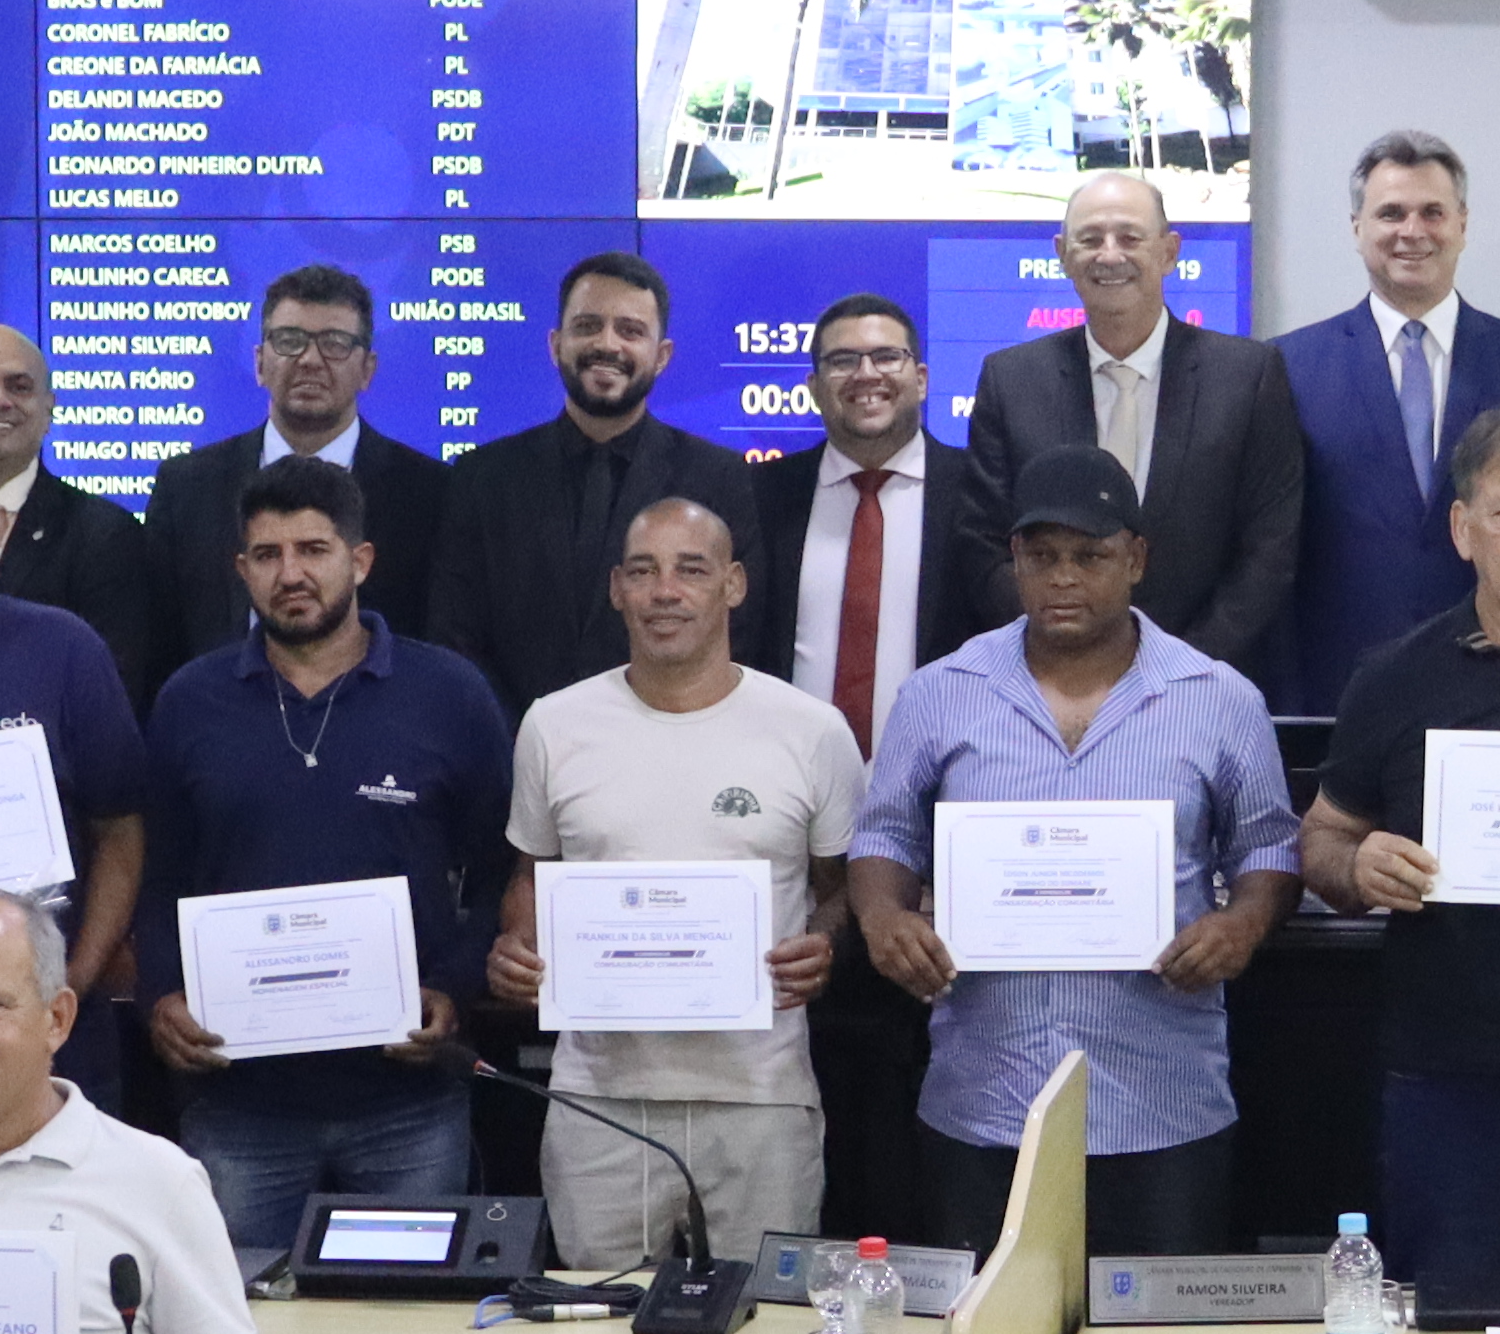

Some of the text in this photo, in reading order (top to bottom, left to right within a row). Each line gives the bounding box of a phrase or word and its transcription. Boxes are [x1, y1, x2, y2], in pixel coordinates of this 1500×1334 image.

[46, 18, 231, 44] CORONEL FABRÍCIO
[444, 22, 469, 42] PL
[47, 51, 262, 76] CREONE DA FARMÁCIA
[445, 55, 469, 76] PL
[48, 89, 224, 110] DELANDI MACEDO
[432, 89, 483, 109] PSDB
[47, 119, 208, 143] JOÃO MACHADO
[437, 122, 477, 142] PDT
[48, 155, 324, 176] LEONARDO PINHEIRO DUTRA
[432, 155, 483, 176] PSDB
[49, 188, 179, 209] LUCAS MELLO
[445, 189, 470, 209] PL
[50, 233, 217, 254] MARCOS COELHO
[440, 234, 476, 254] PSB
[50, 267, 230, 287] PAULINHO CARECA
[431, 267, 485, 287] PODE
[1177, 260, 1201, 280] 19
[50, 301, 252, 321] PAULINHO MOTOBOY
[390, 297, 526, 322] UNIÃO BRASIL
[51, 335, 213, 356] RAMON SILVEIRA
[434, 336, 485, 356] PSDB
[51, 366, 195, 390] RENATA FIÓRIO
[446, 371, 472, 391] PP
[52, 400, 205, 426] SANDRO IRMÃO
[440, 407, 479, 427] PDT
[52, 441, 127, 460] THIAGO
[1177, 1283, 1286, 1295] RAMON SILVEIRA
